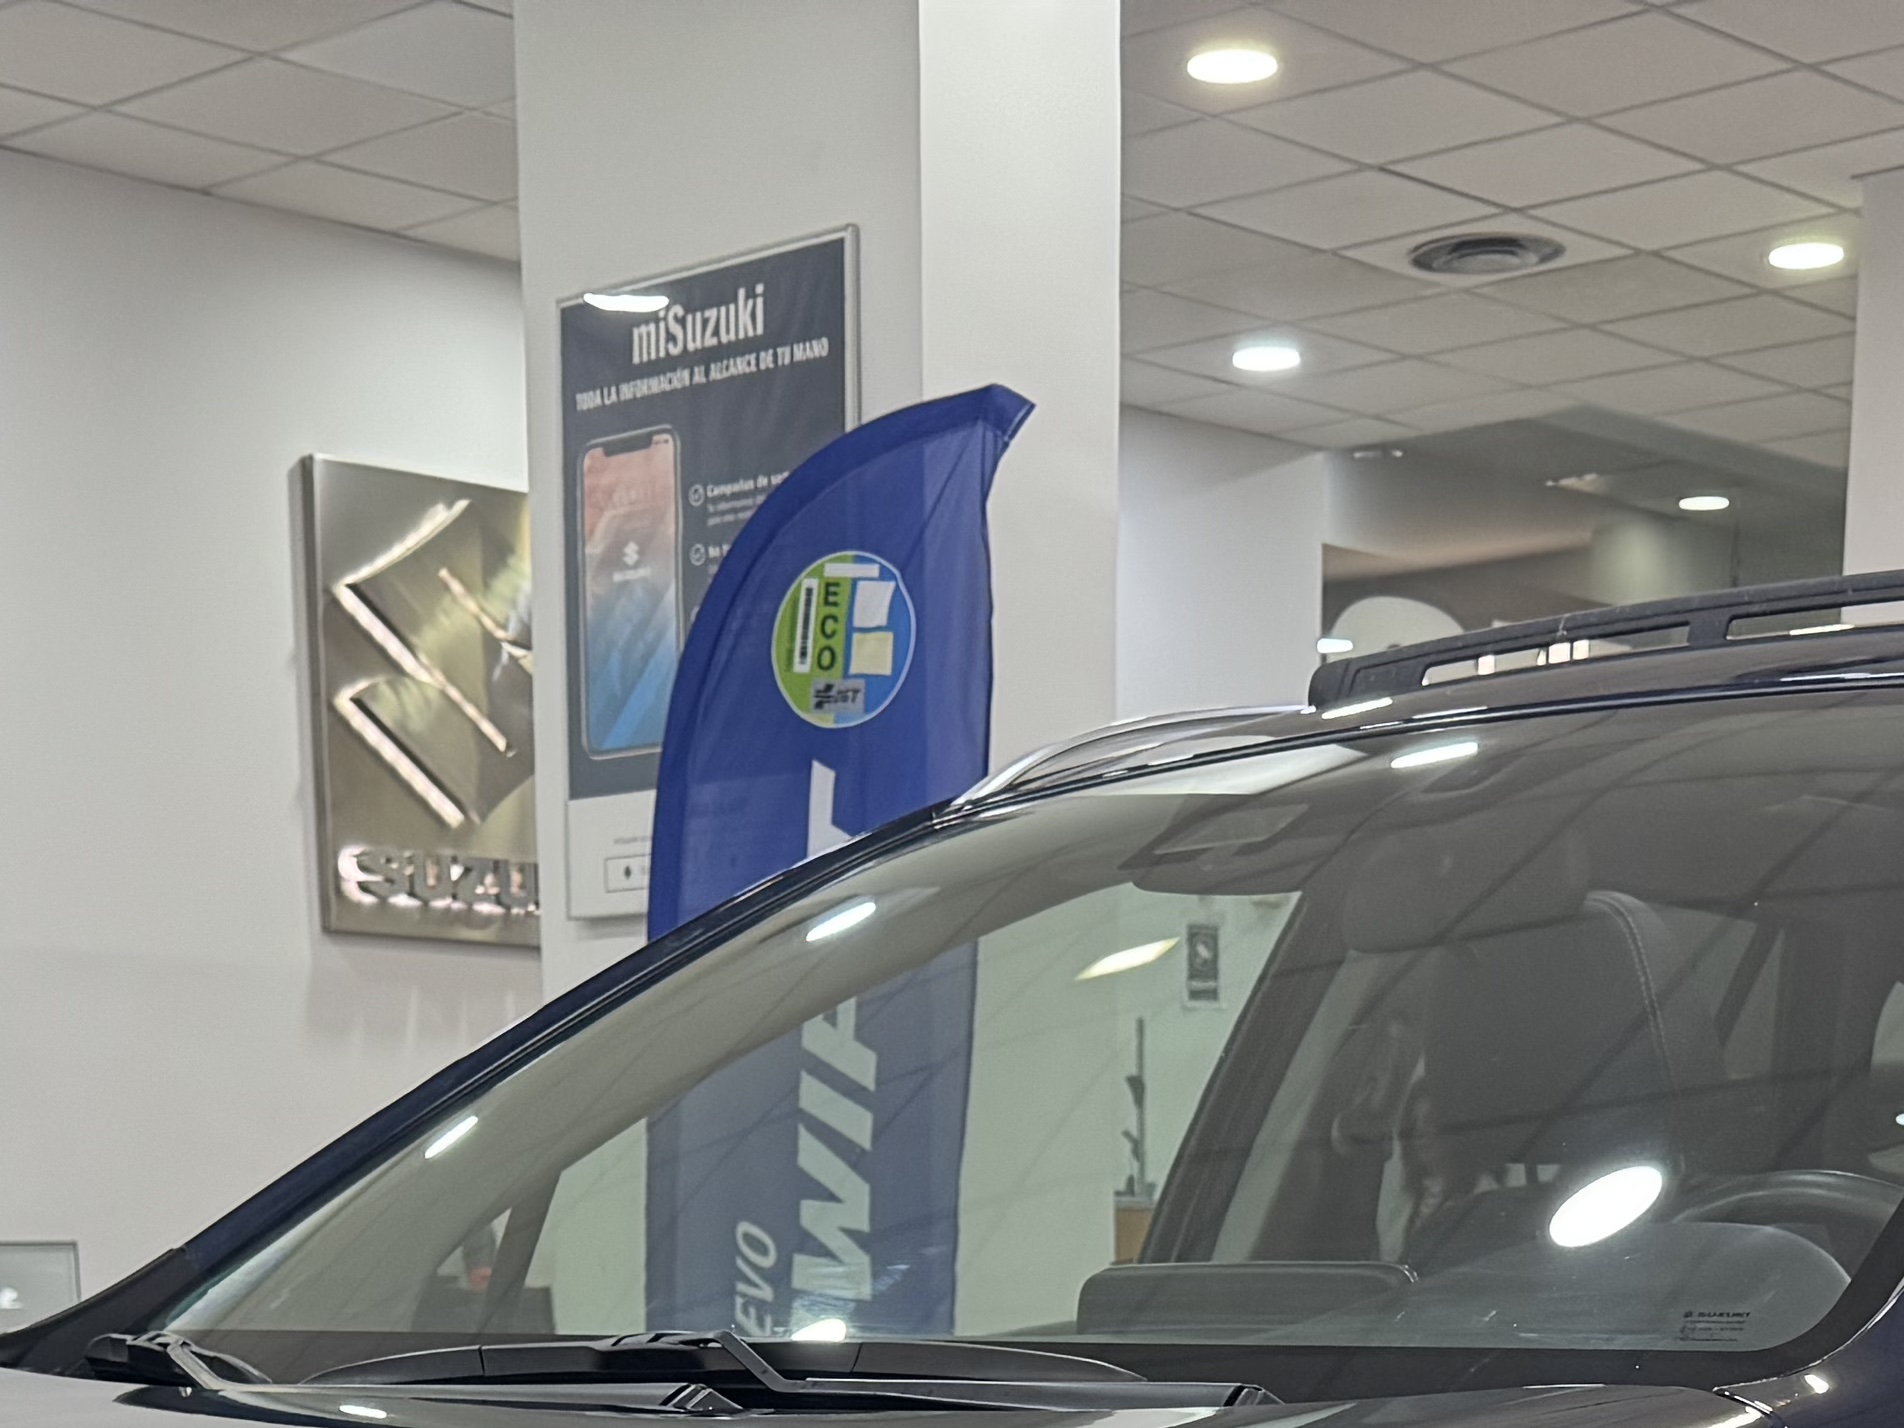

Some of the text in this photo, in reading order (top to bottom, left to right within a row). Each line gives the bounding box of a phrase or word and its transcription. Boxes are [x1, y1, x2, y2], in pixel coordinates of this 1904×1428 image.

[632, 282, 764, 365] miSuzuki
[603, 385, 618, 405] LA
[618, 366, 691, 402] INFORMACIÓN
[692, 365, 707, 384] AL
[709, 353, 757, 381] ALCANCE
[759, 349, 774, 370] DE
[777, 345, 791, 366] TU
[793, 337, 829, 362] MANO
[817, 581, 840, 671] ECO
